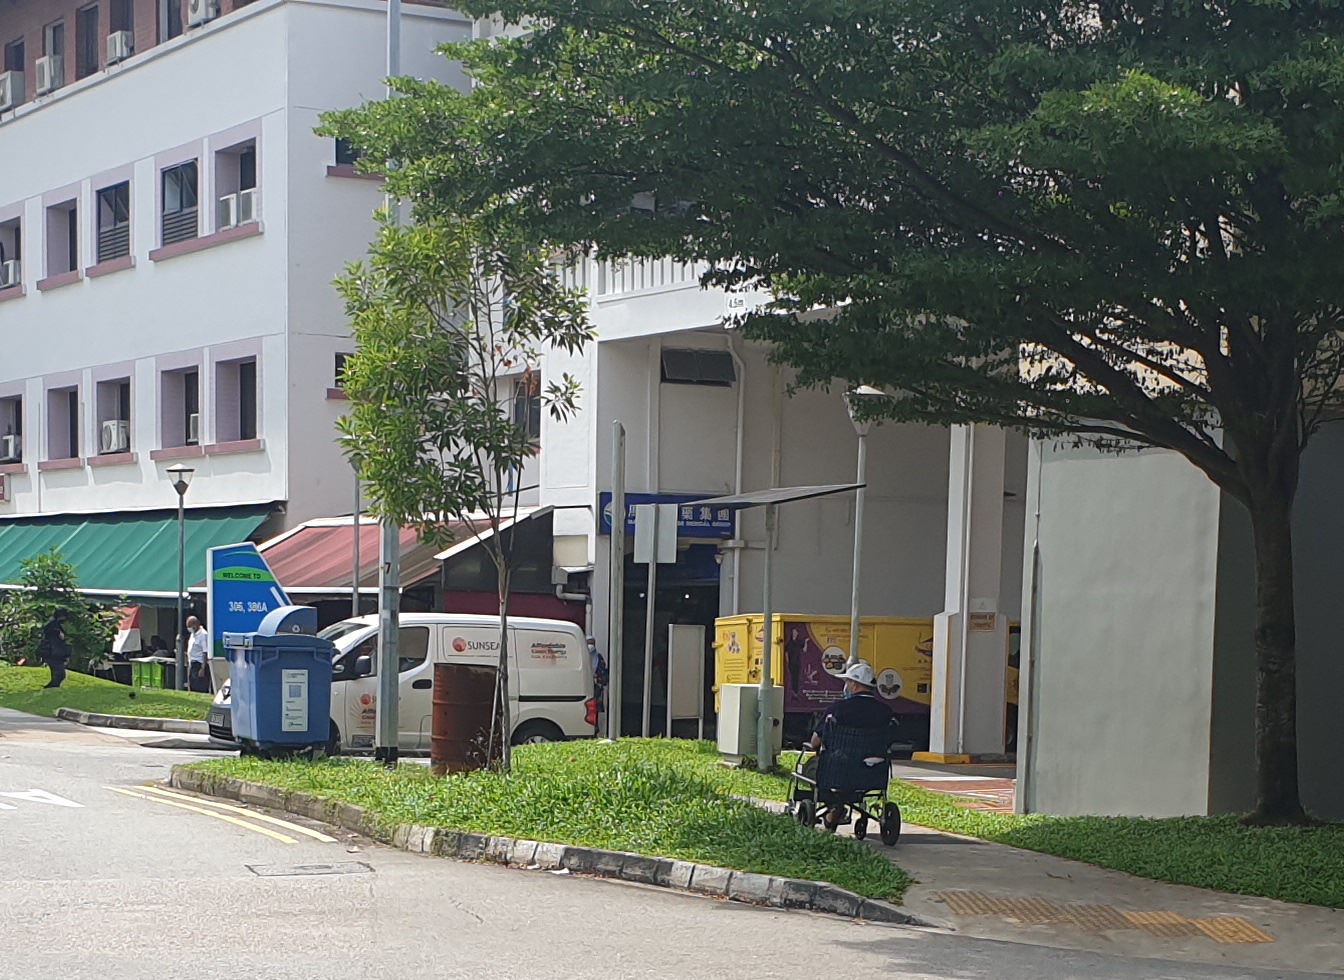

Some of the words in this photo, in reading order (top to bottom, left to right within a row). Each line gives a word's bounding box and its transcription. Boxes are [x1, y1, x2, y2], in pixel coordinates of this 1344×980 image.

[385, 562, 391, 575] 7
[222, 572, 252, 580] WELCOME
[467, 640, 503, 651] SUNSEA
